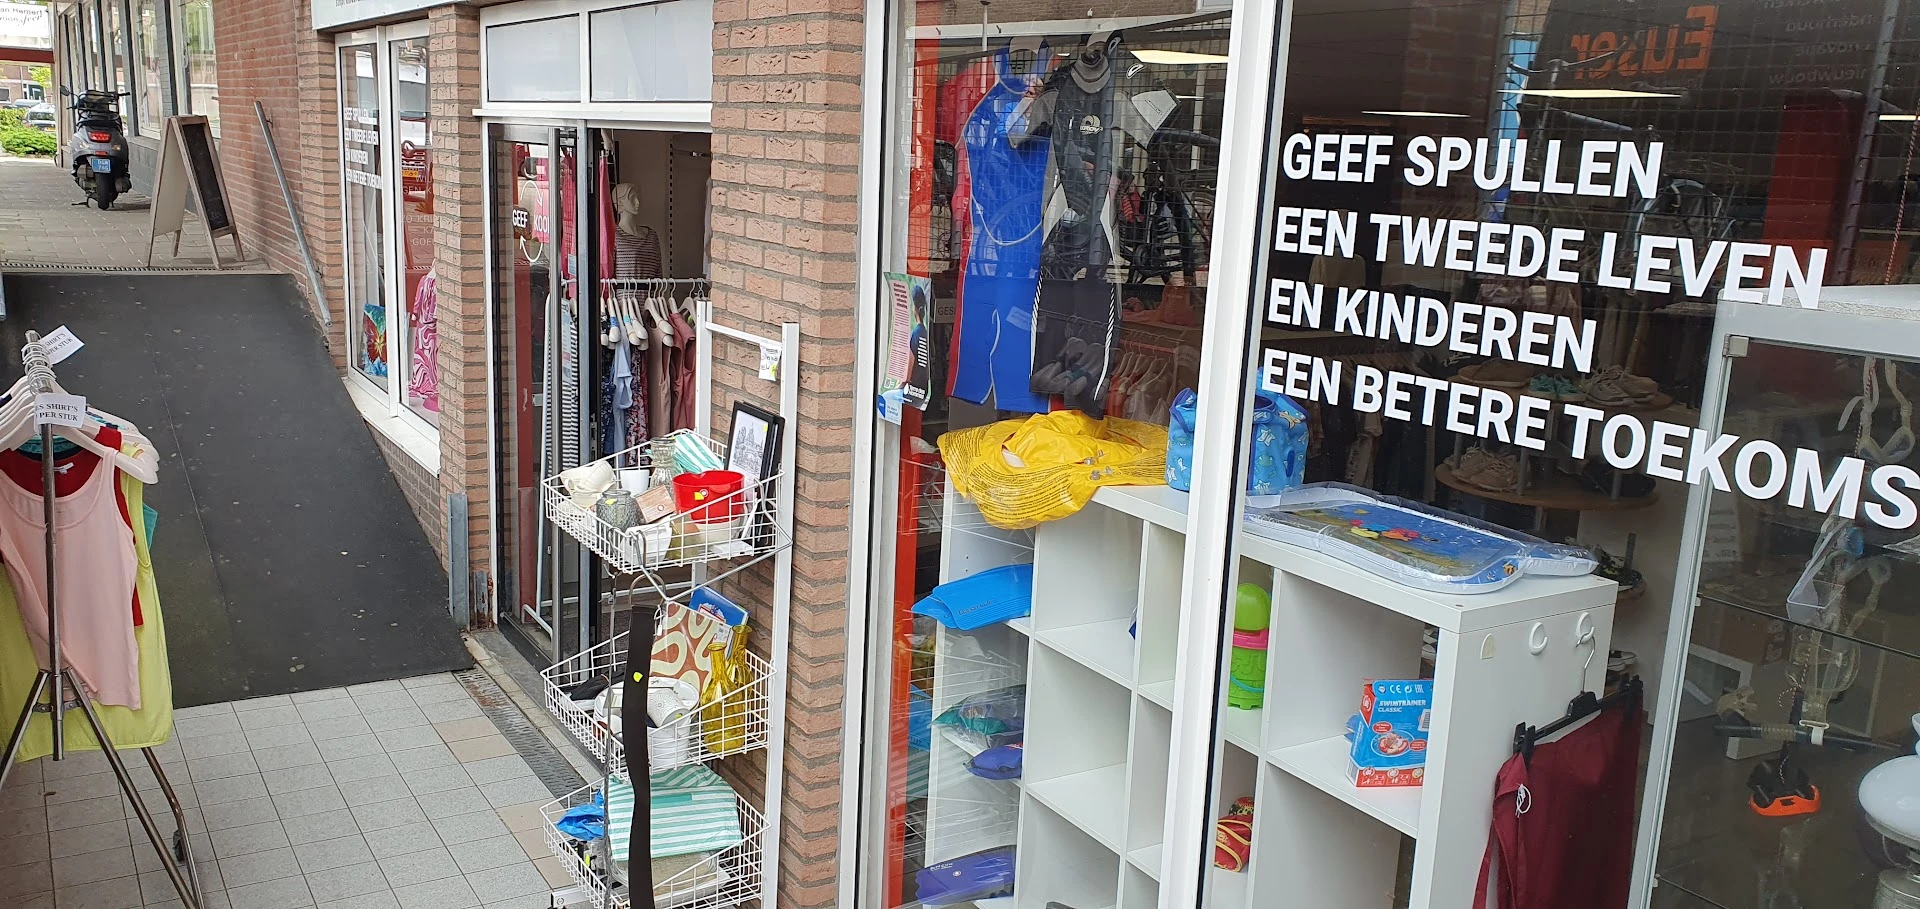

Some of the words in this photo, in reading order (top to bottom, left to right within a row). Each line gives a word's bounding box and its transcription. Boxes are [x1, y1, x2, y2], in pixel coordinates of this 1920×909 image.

[1282, 133, 1394, 183] GEEF
[1404, 136, 1664, 199] SPULLEN
[512, 209, 528, 229] GEEF
[1274, 207, 1358, 258] EEN
[1370, 214, 1587, 282] TWEEDE
[1597, 237, 1828, 309] LEVEN
[1268, 278, 1324, 329] EN
[1334, 288, 1597, 373] KINDEREN
[45, 332, 66, 346] SHIRT'S
[58, 337, 74, 348] STUK
[1261, 348, 1342, 406] EEN
[1352, 364, 1552, 450] BETERE
[39, 411, 57, 419] PER
[58, 412, 78, 421] STUK
[46, 403, 79, 413] SHIRT'S
[1379, 699, 1427, 707] SWIMTRAINER
